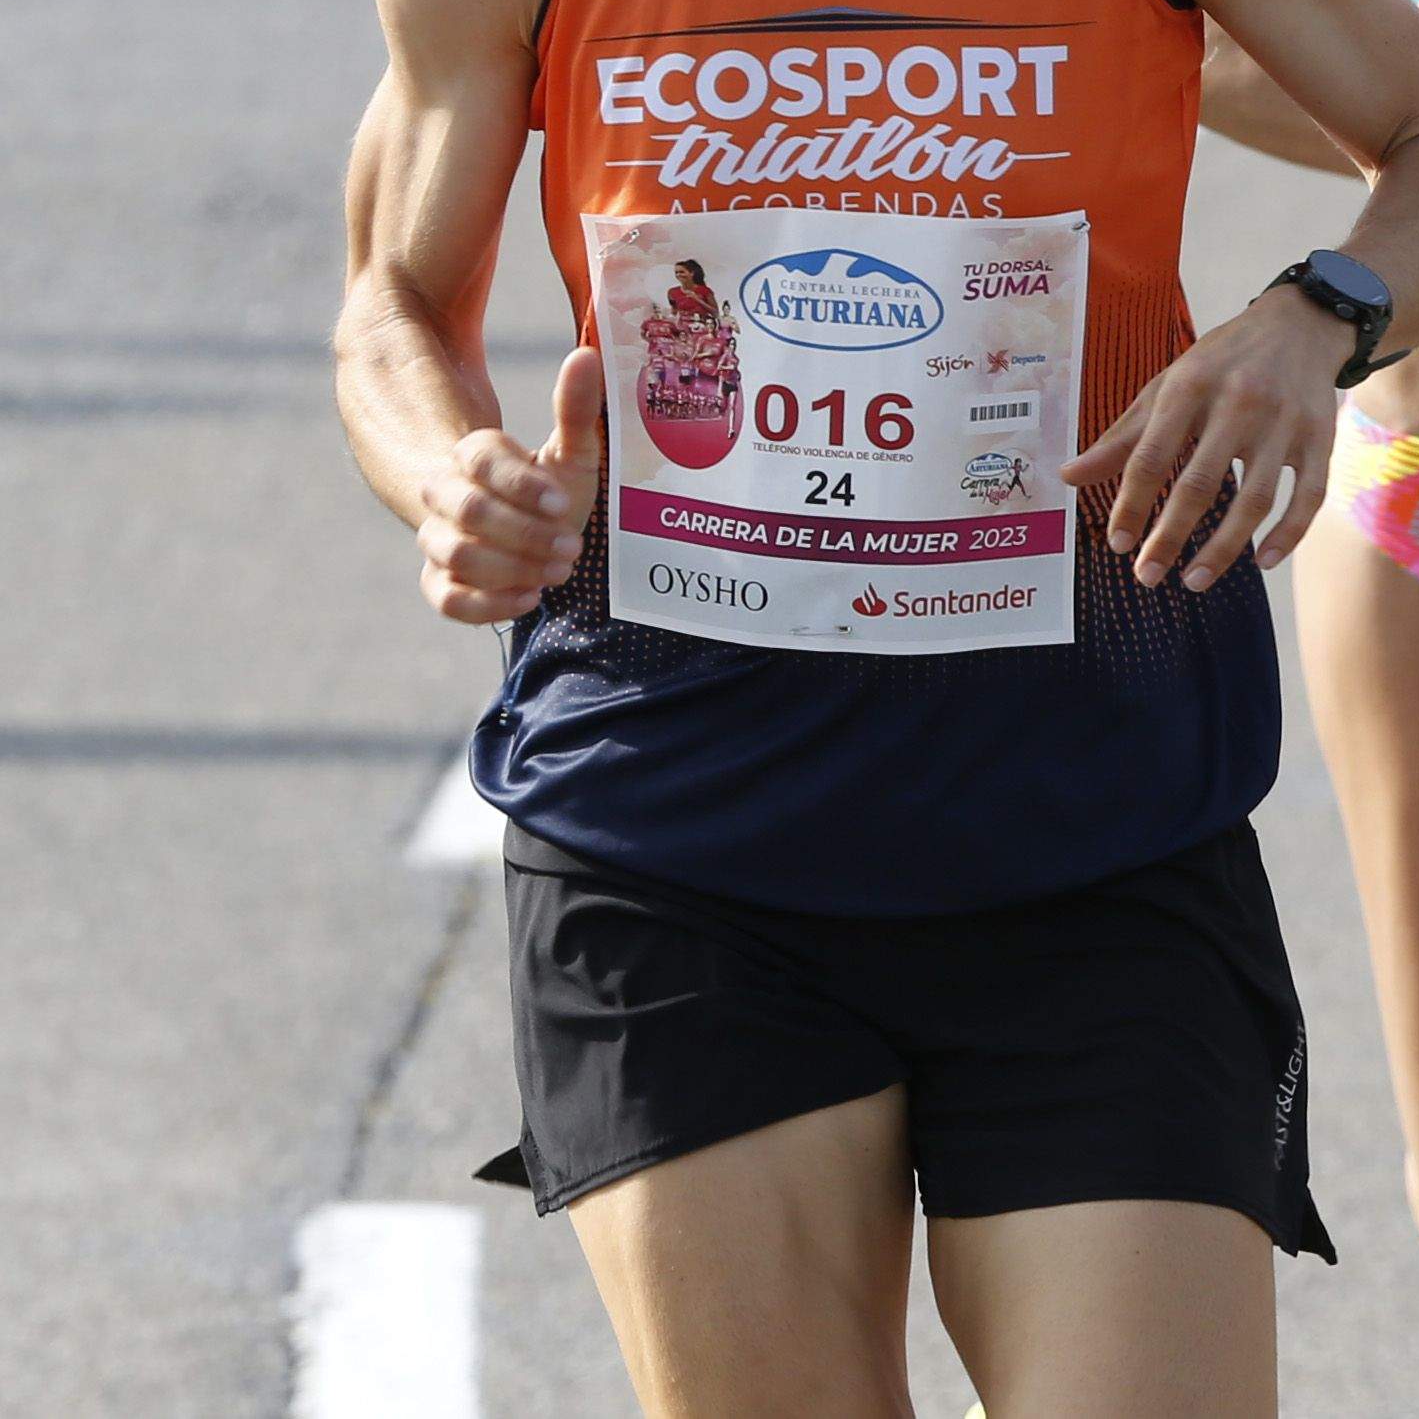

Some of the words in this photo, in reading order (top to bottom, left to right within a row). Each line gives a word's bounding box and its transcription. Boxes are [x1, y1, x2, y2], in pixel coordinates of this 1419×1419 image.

[596, 45, 1068, 124] ECOSPORT
[963, 263, 984, 277] TU
[987, 259, 1053, 276] DORSAL
[752, 278, 927, 329] ASTURIANA
[780, 279, 844, 295] CENTRAL
[852, 285, 921, 299] LECHERA
[963, 274, 1050, 301] SUMA
[926, 354, 974, 377] gijón
[755, 384, 915, 450] 016
[803, 447, 854, 459] VIOLENCIA
[856, 451, 869, 460] DE
[872, 451, 914, 463] GÉNERO
[805, 470, 855, 507] 24
[660, 507, 768, 544] CARRERA
[775, 528, 814, 549] DE
[819, 532, 855, 552] LA
[862, 532, 959, 554] MUJER
[969, 525, 1028, 551] 2023
[649, 563, 768, 612] OYSHO
[893, 585, 1038, 617] Santander
